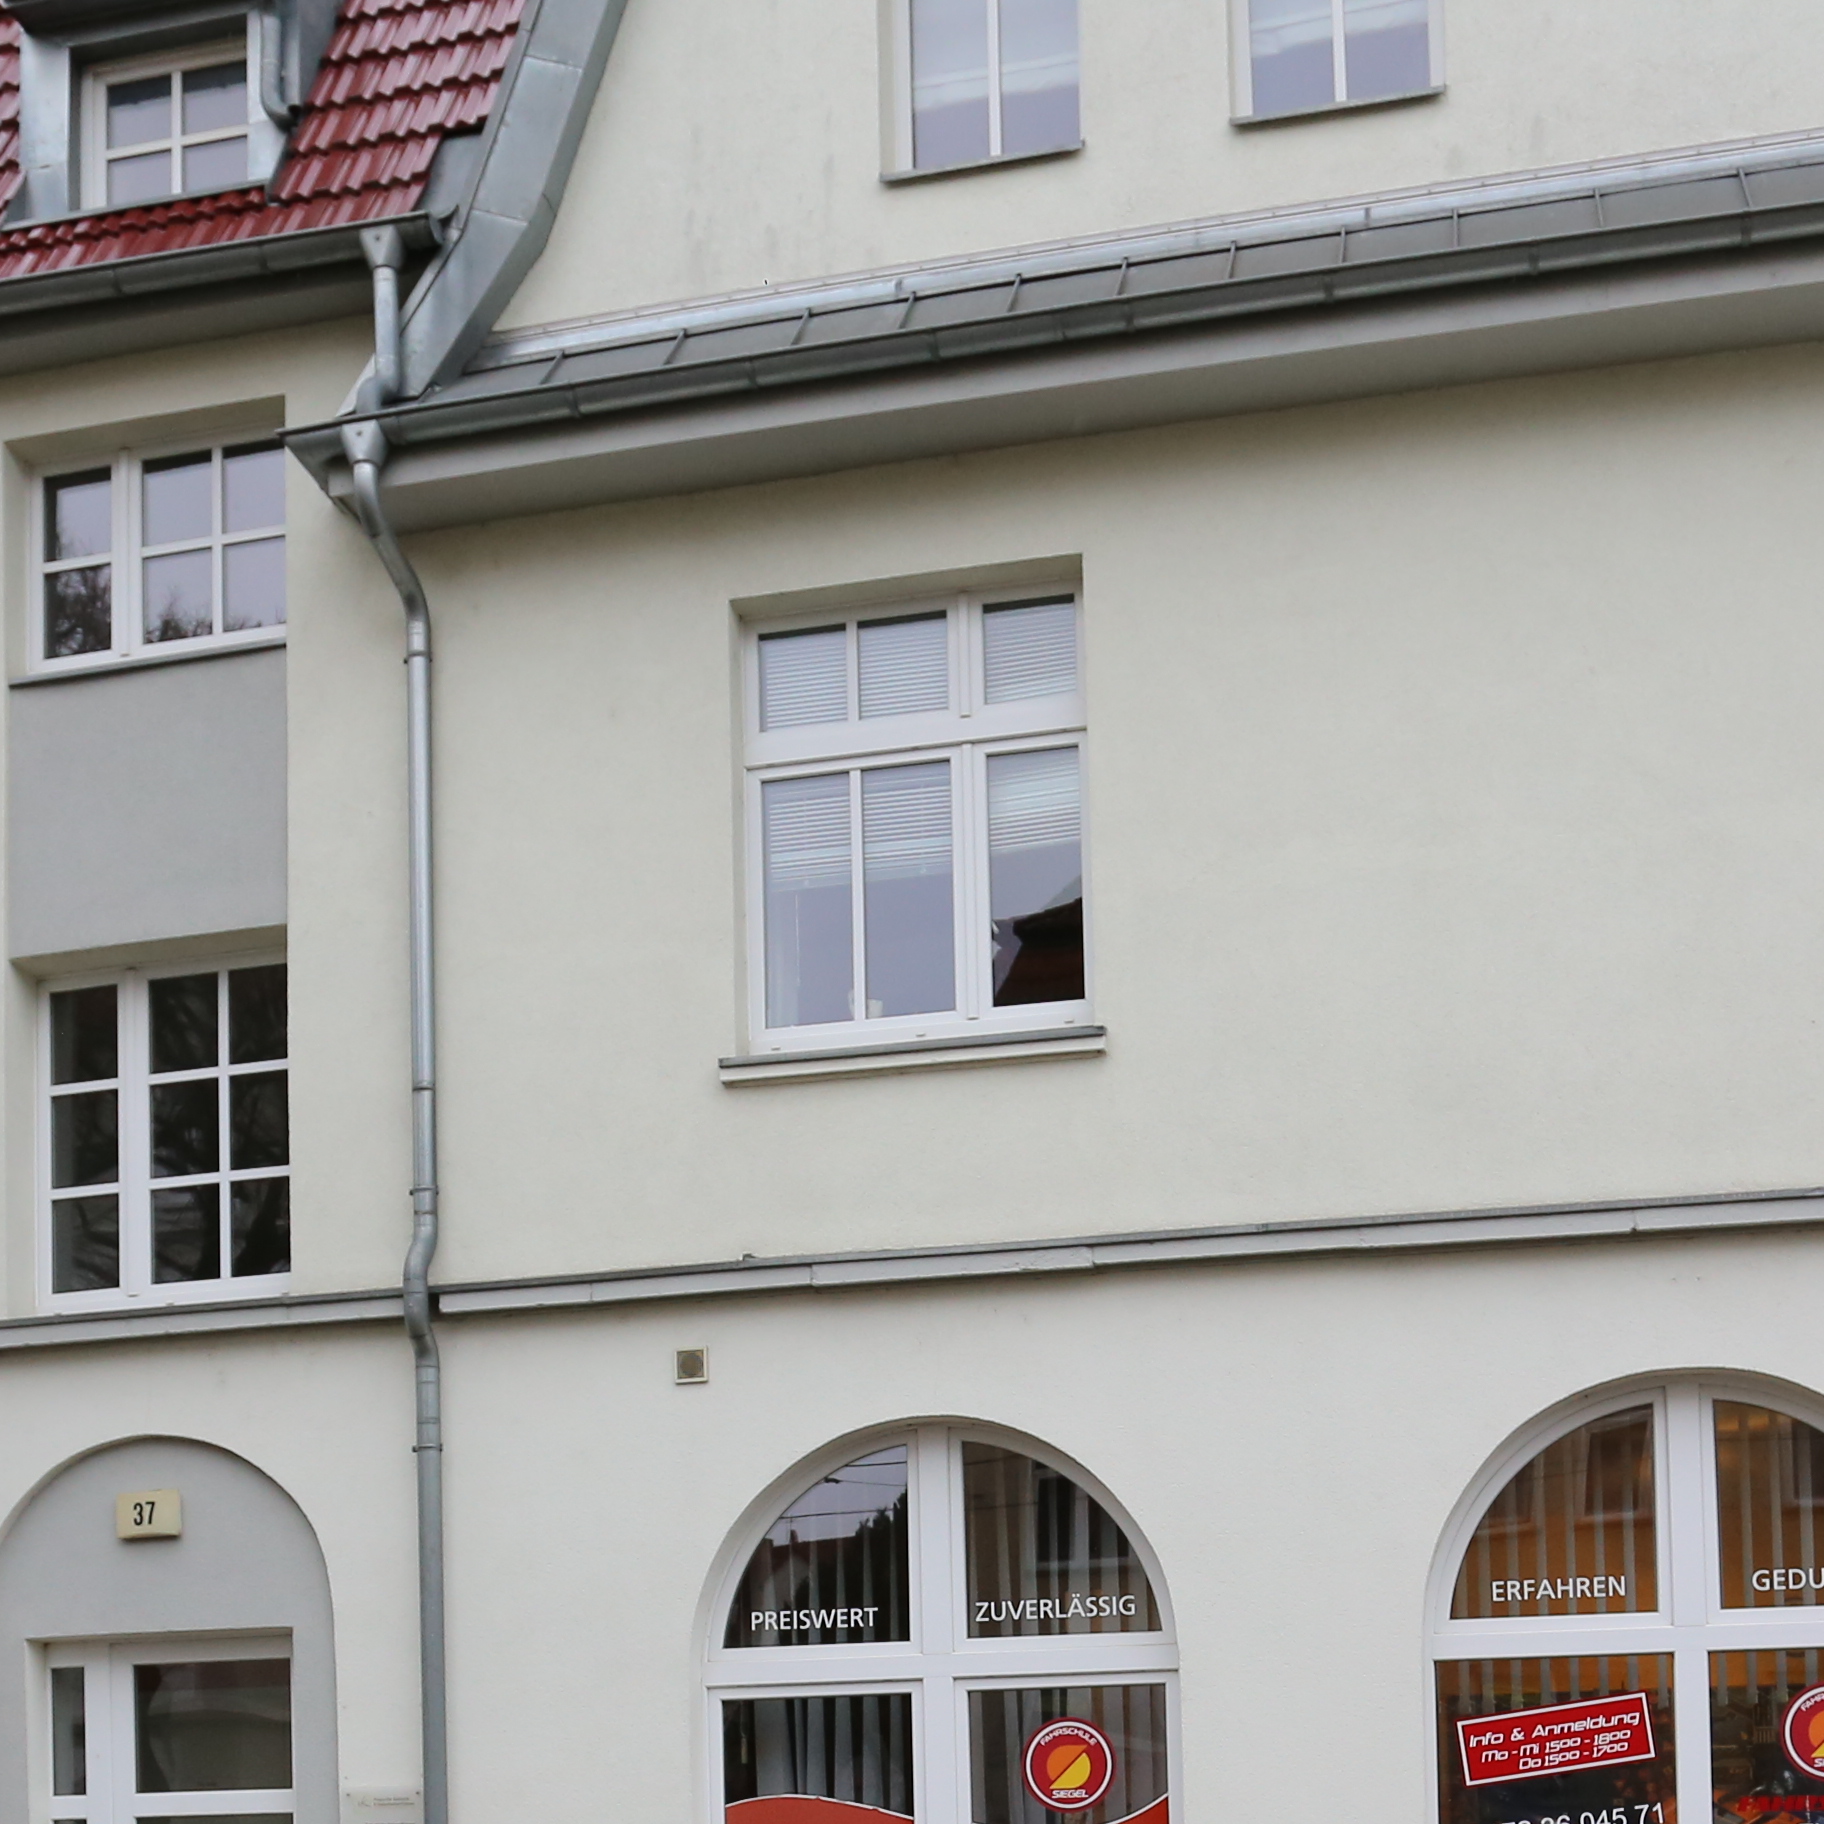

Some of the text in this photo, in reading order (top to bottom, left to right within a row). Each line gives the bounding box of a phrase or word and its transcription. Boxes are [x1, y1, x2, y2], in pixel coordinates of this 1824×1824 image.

[133, 1501, 155, 1526] 37
[1491, 1576, 1626, 1602] ERFAHREN
[750, 1607, 879, 1631] PREISWERT
[975, 1594, 1136, 1623] ZUVERLÄSSIG
[1039, 1727, 1097, 1746] FAHRSCHULE
[1469, 1711, 1640, 1748] Info & Anmeldung
[1519, 1757, 1542, 1770] Do
[1051, 1789, 1089, 1799] SIEGEL
